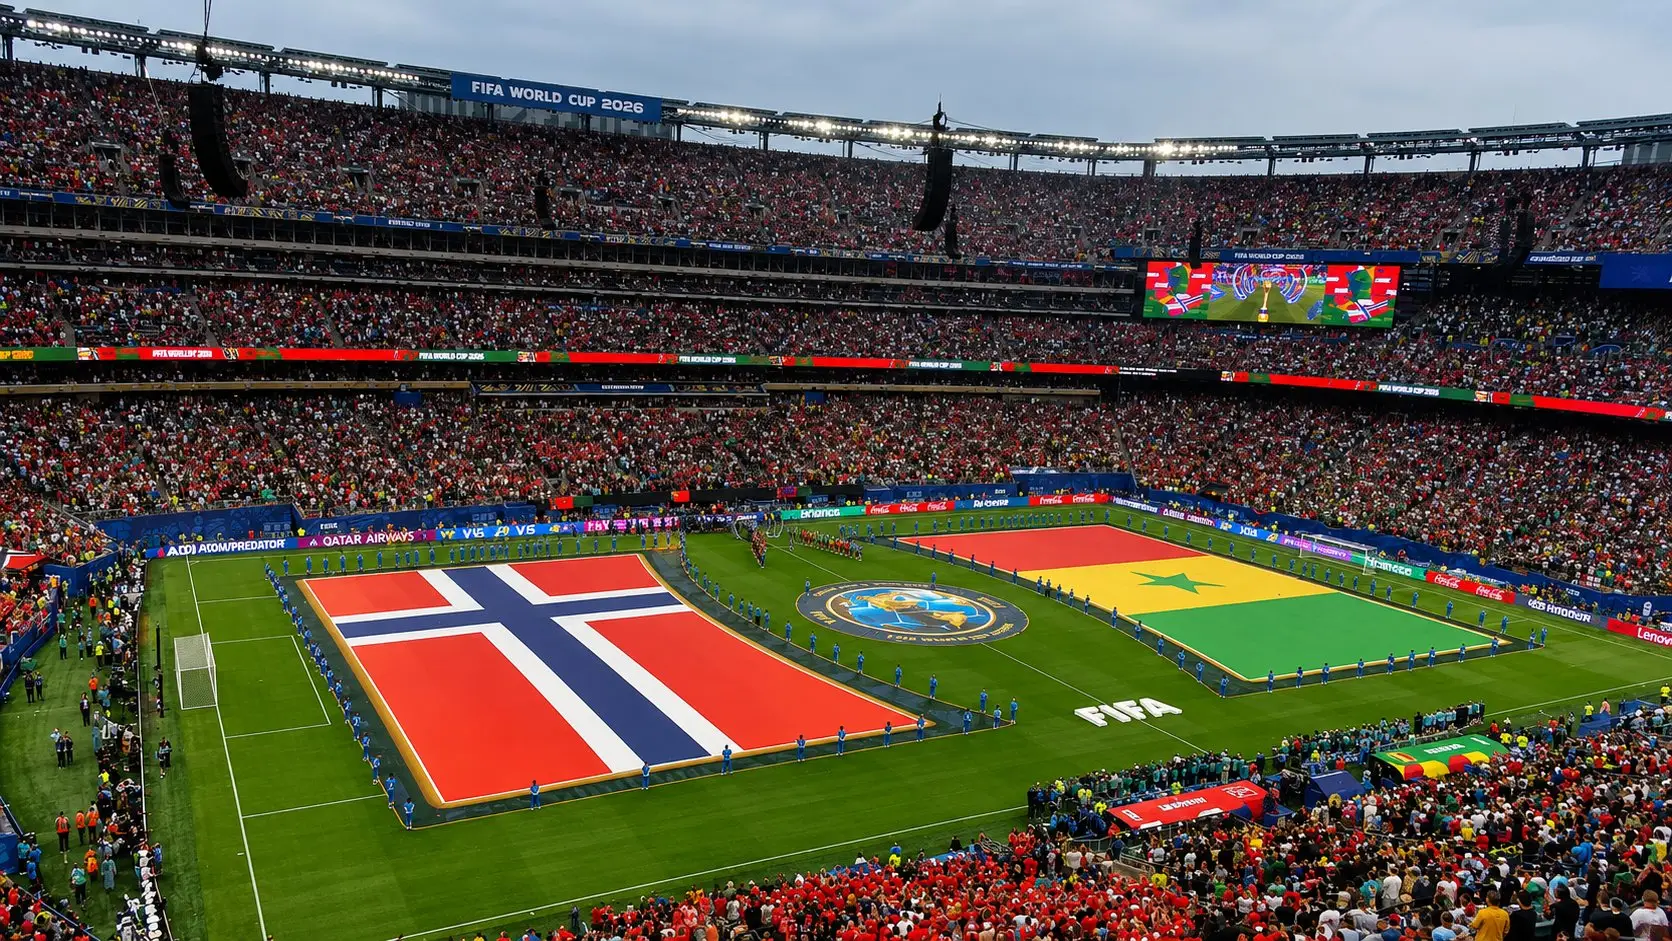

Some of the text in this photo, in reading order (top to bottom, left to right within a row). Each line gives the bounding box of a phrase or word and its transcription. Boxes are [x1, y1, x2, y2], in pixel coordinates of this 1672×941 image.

[472, 81, 644, 114] FIFA WORLD CUP 2026
[323, 531, 415, 546] QATAR AIRWAYS
[1637, 627, 1672, 645] Lenov
[1074, 697, 1183, 727] FIFA
